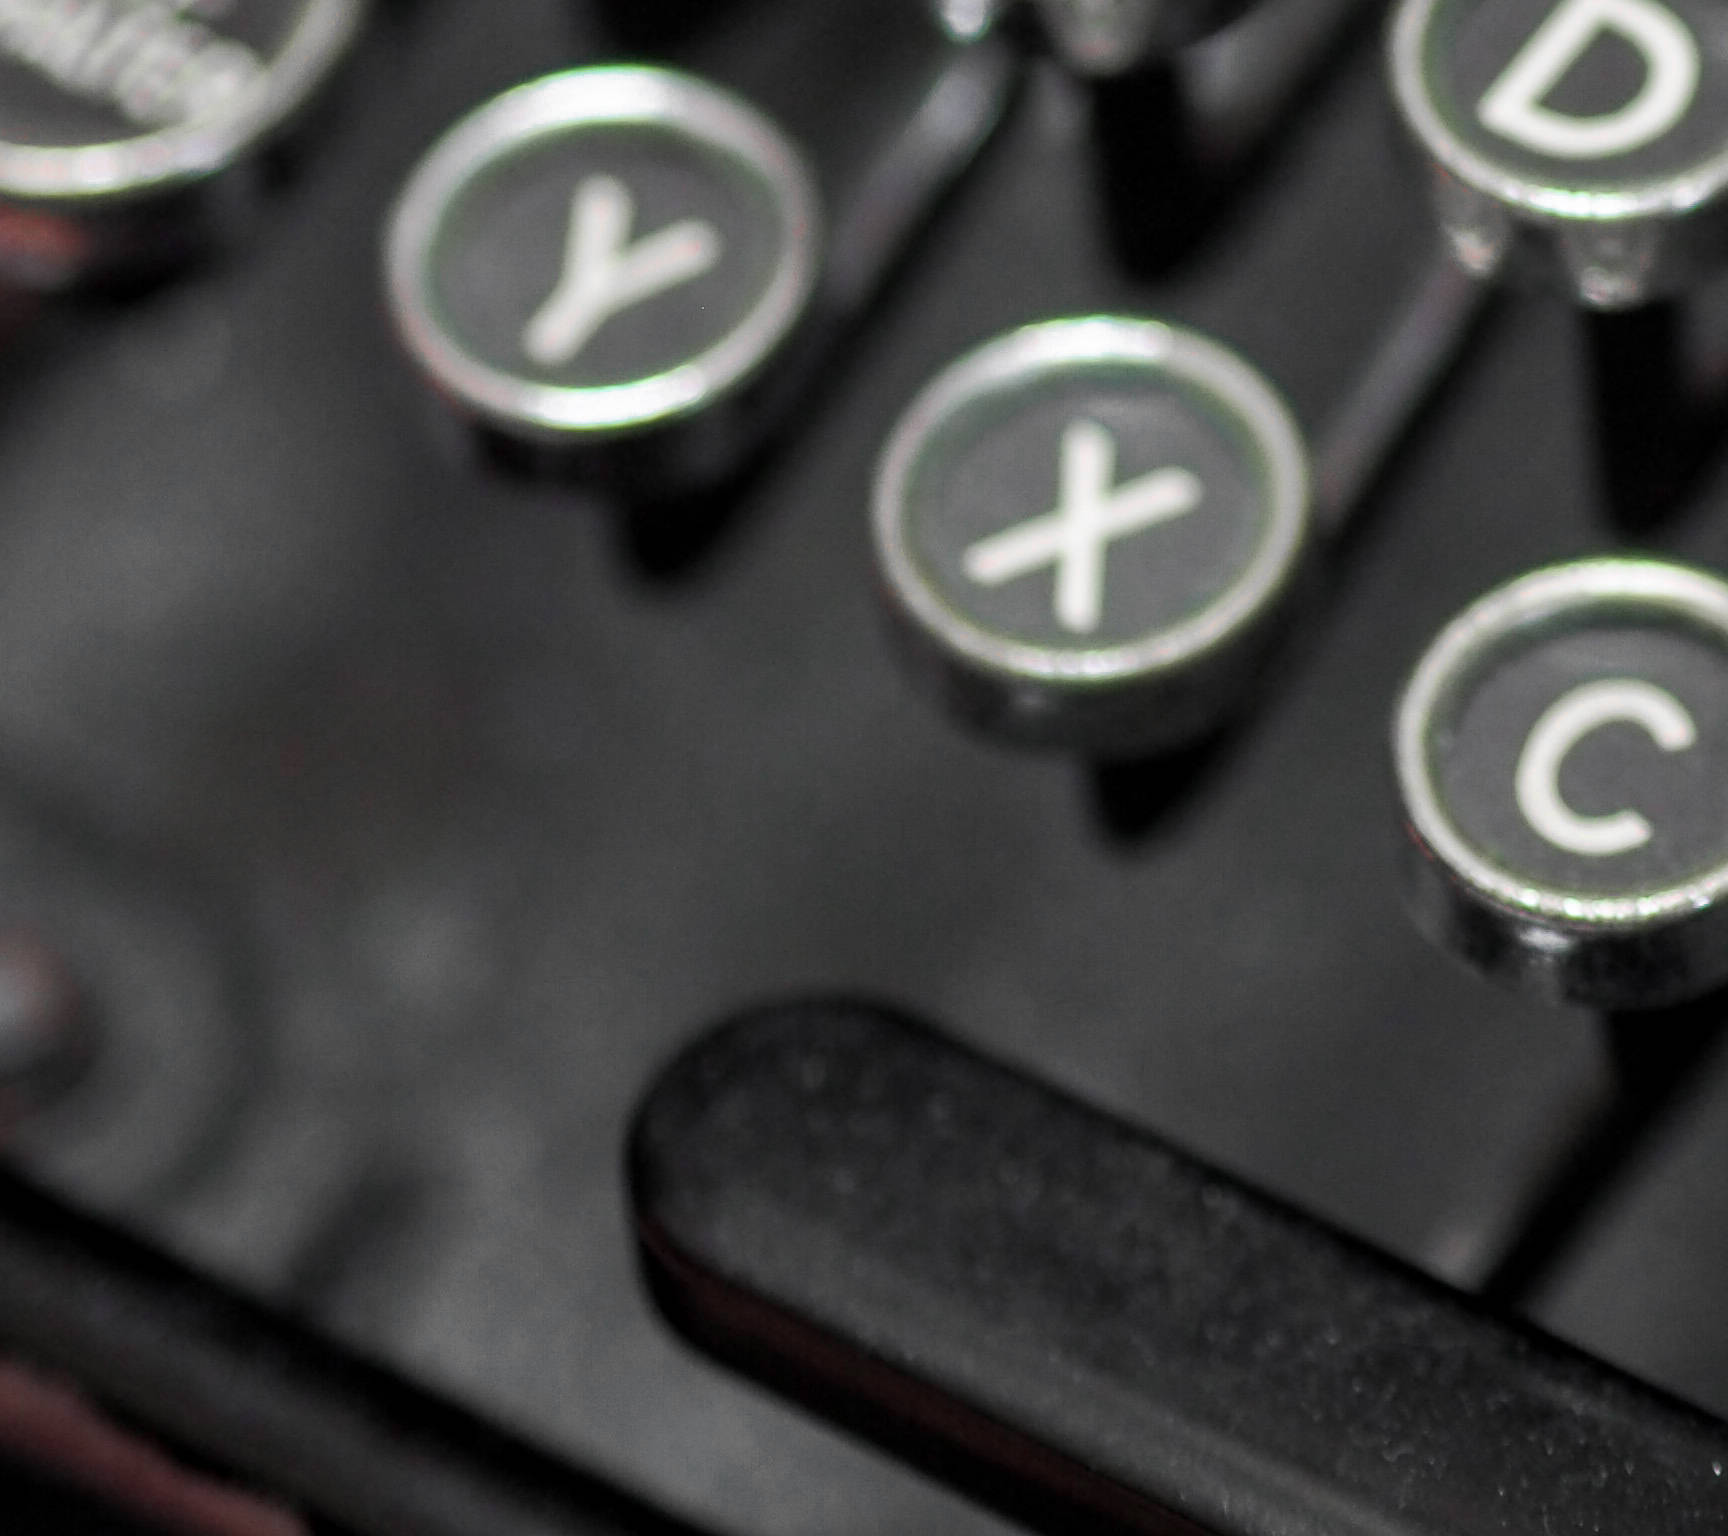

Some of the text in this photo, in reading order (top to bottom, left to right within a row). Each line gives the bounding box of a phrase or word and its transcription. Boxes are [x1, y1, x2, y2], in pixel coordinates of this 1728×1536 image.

[522, 175, 720, 366] Y
[960, 416, 1204, 637] X
[1513, 675, 1699, 858] C
